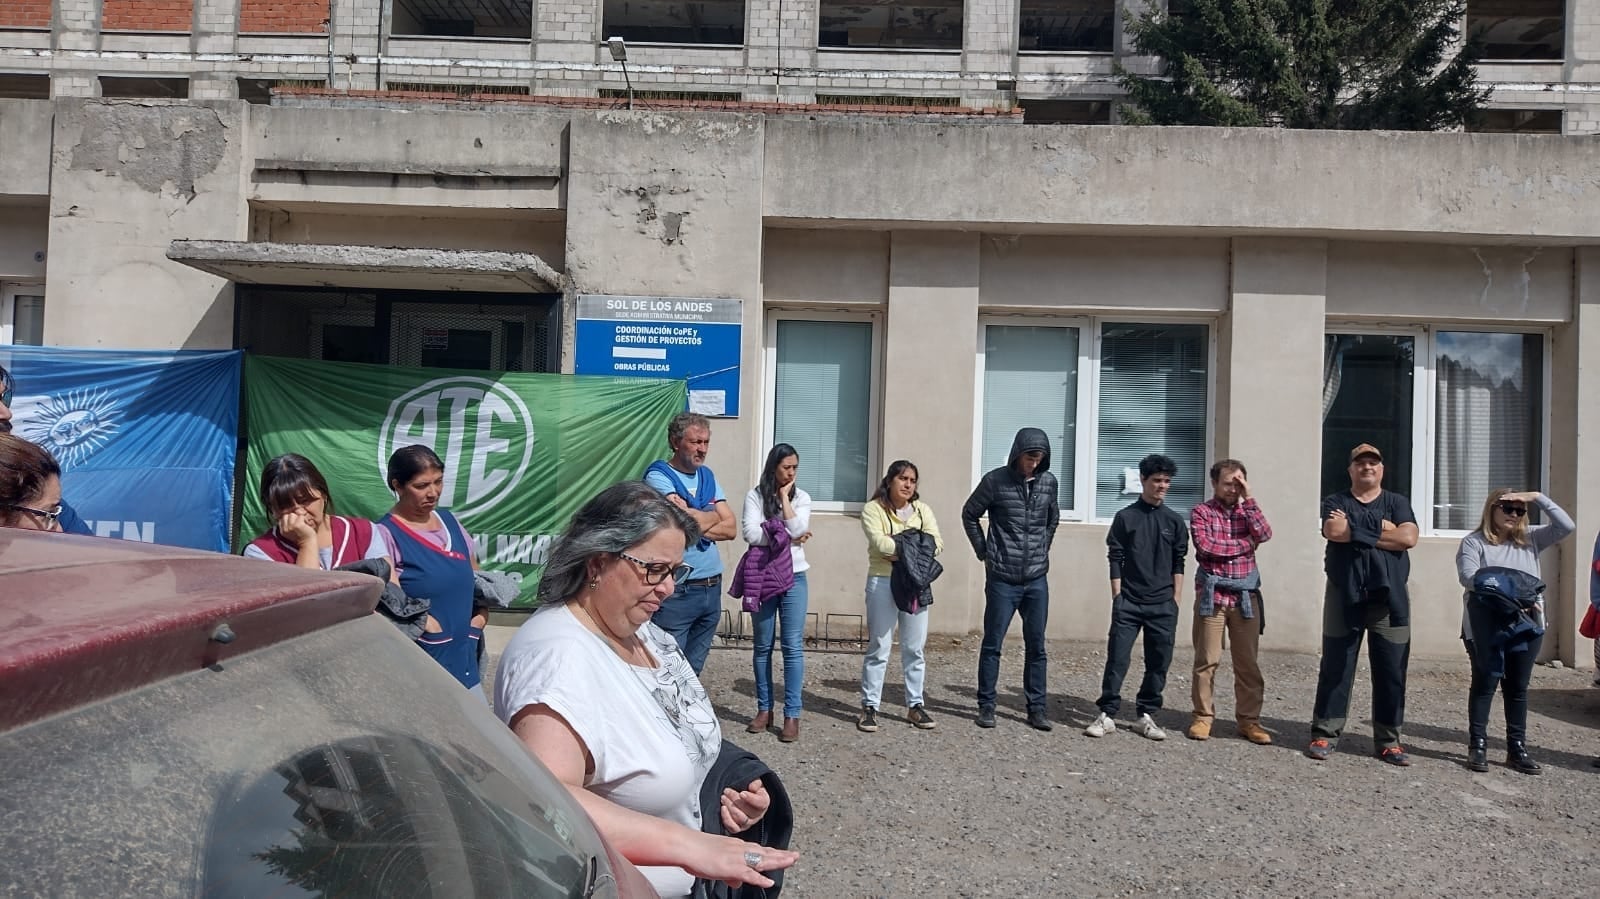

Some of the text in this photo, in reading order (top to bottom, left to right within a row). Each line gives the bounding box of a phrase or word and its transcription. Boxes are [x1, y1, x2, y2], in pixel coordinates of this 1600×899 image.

[606, 300, 713, 313] SOL DE LOS ANDES
[615, 325, 698, 338] COORDINACIÓN CoPE y
[615, 334, 702, 345] GESTIÓN DE PROYECTOS
[614, 362, 670, 372] OBRAS PÚBLICAS
[391, 386, 518, 507] ATE
[493, 534, 560, 565] MAR
